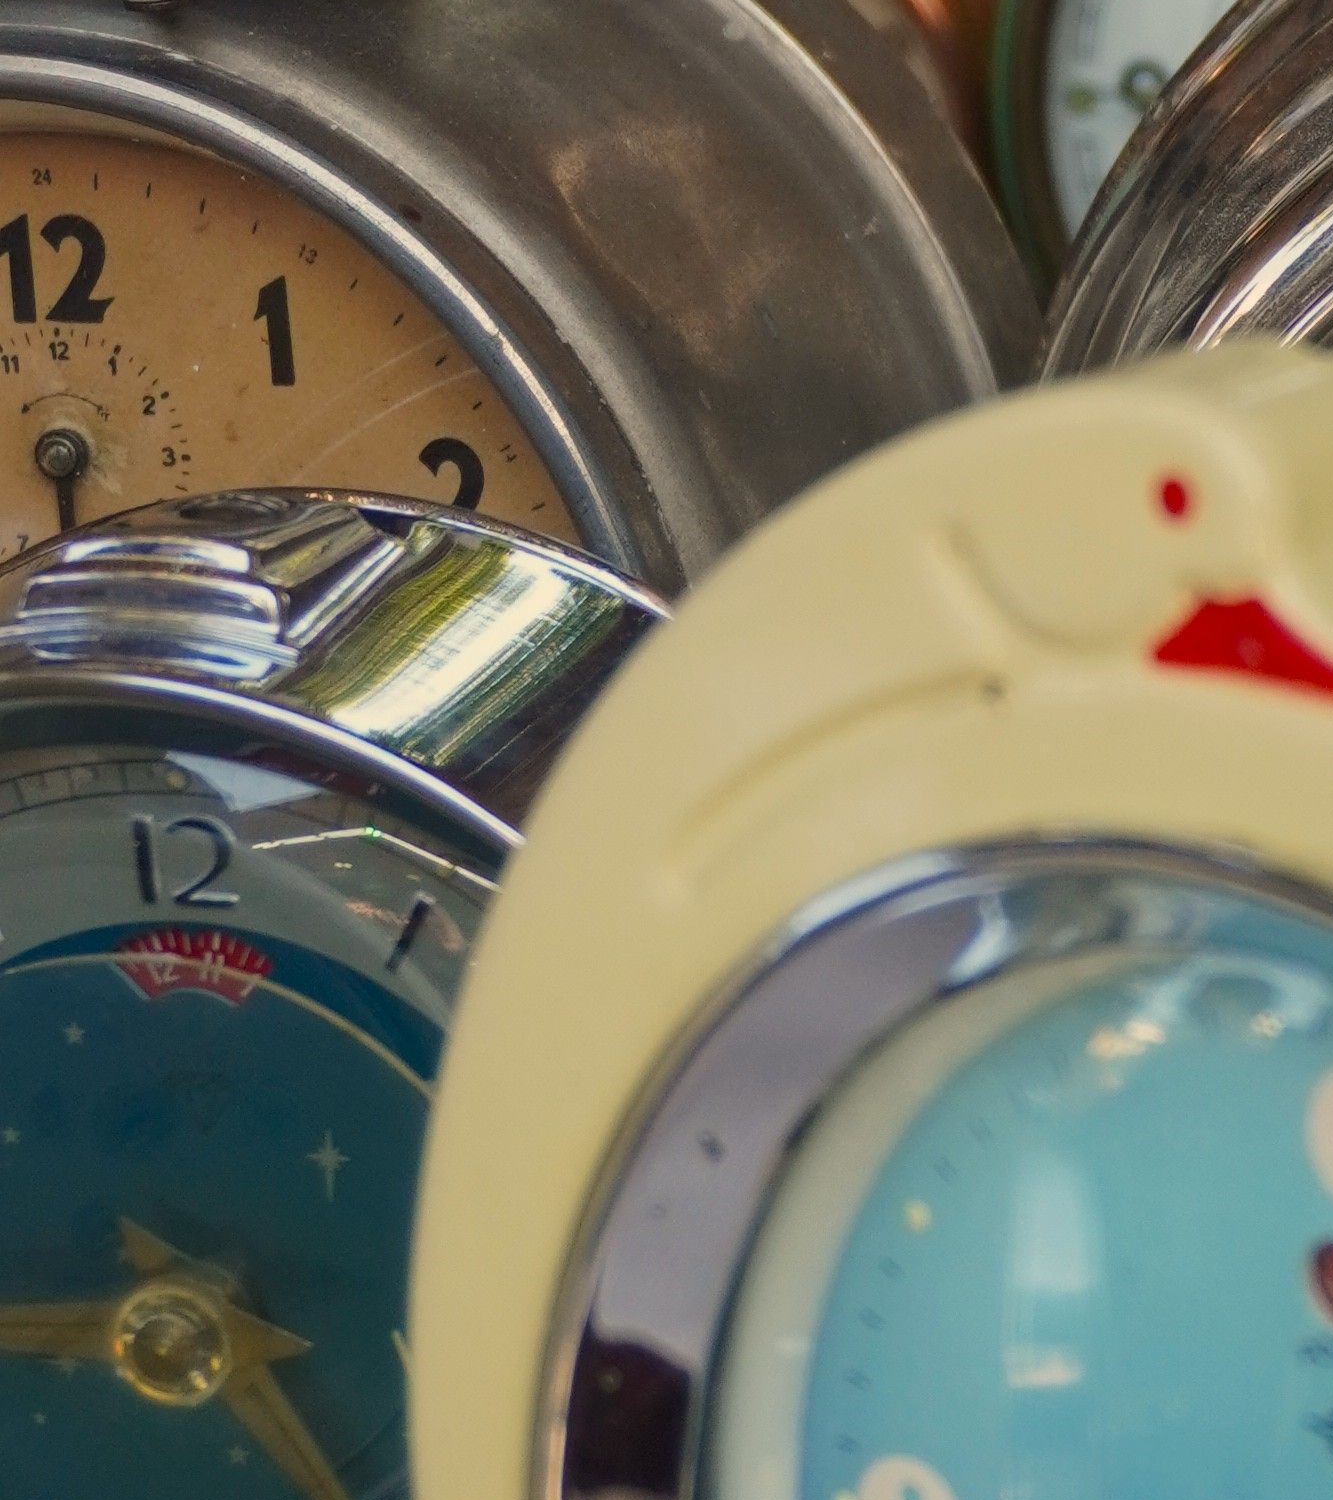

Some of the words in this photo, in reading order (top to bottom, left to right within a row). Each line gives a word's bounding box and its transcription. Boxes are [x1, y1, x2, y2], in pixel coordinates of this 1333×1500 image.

[32, 168, 51, 186] 24
[0, 213, 115, 323] 12
[253, 275, 295, 386] 1
[49, 341, 69, 361] 12
[1, 354, 20, 375] 11
[108, 355, 118, 376] 1
[142, 395, 156, 416] 2
[161, 446, 176, 467] 3
[132, 814, 241, 909] 12
